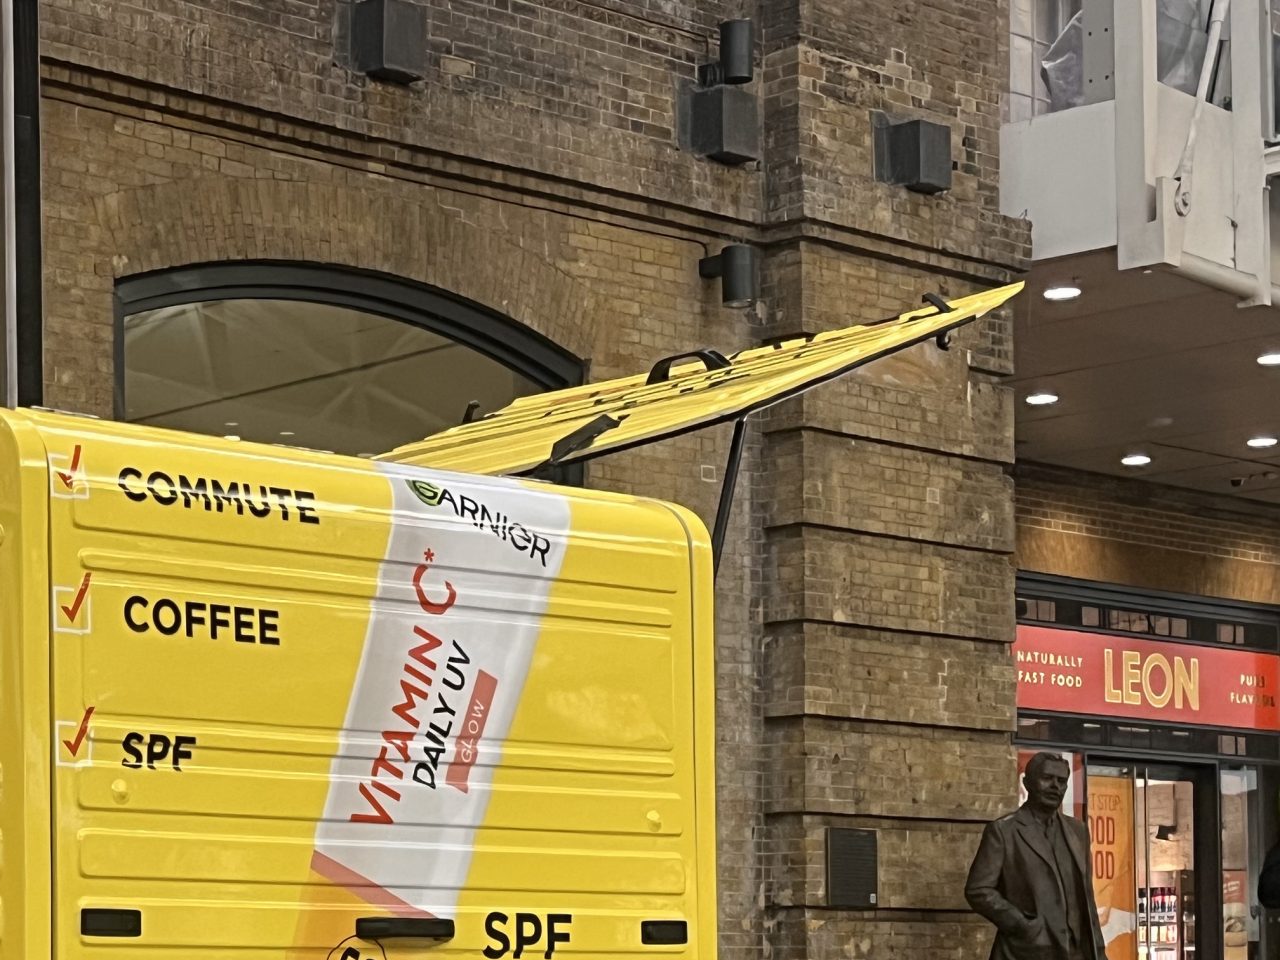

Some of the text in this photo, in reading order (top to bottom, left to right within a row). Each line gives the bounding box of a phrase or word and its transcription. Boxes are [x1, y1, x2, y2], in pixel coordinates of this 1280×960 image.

[118, 465, 320, 525] COMMUTE
[412, 479, 551, 568] GARNIER
[123, 595, 281, 646] COFFEE
[1016, 649, 1084, 668] NATURALLY
[1017, 669, 1083, 688] FAST FOOD
[1103, 648, 1200, 711] LEON
[349, 624, 444, 825] VITAMIN
[412, 638, 471, 790] DAILY UV
[460, 699, 486, 764] GLOW
[121, 731, 197, 773] SPF
[482, 911, 573, 960] SPF
